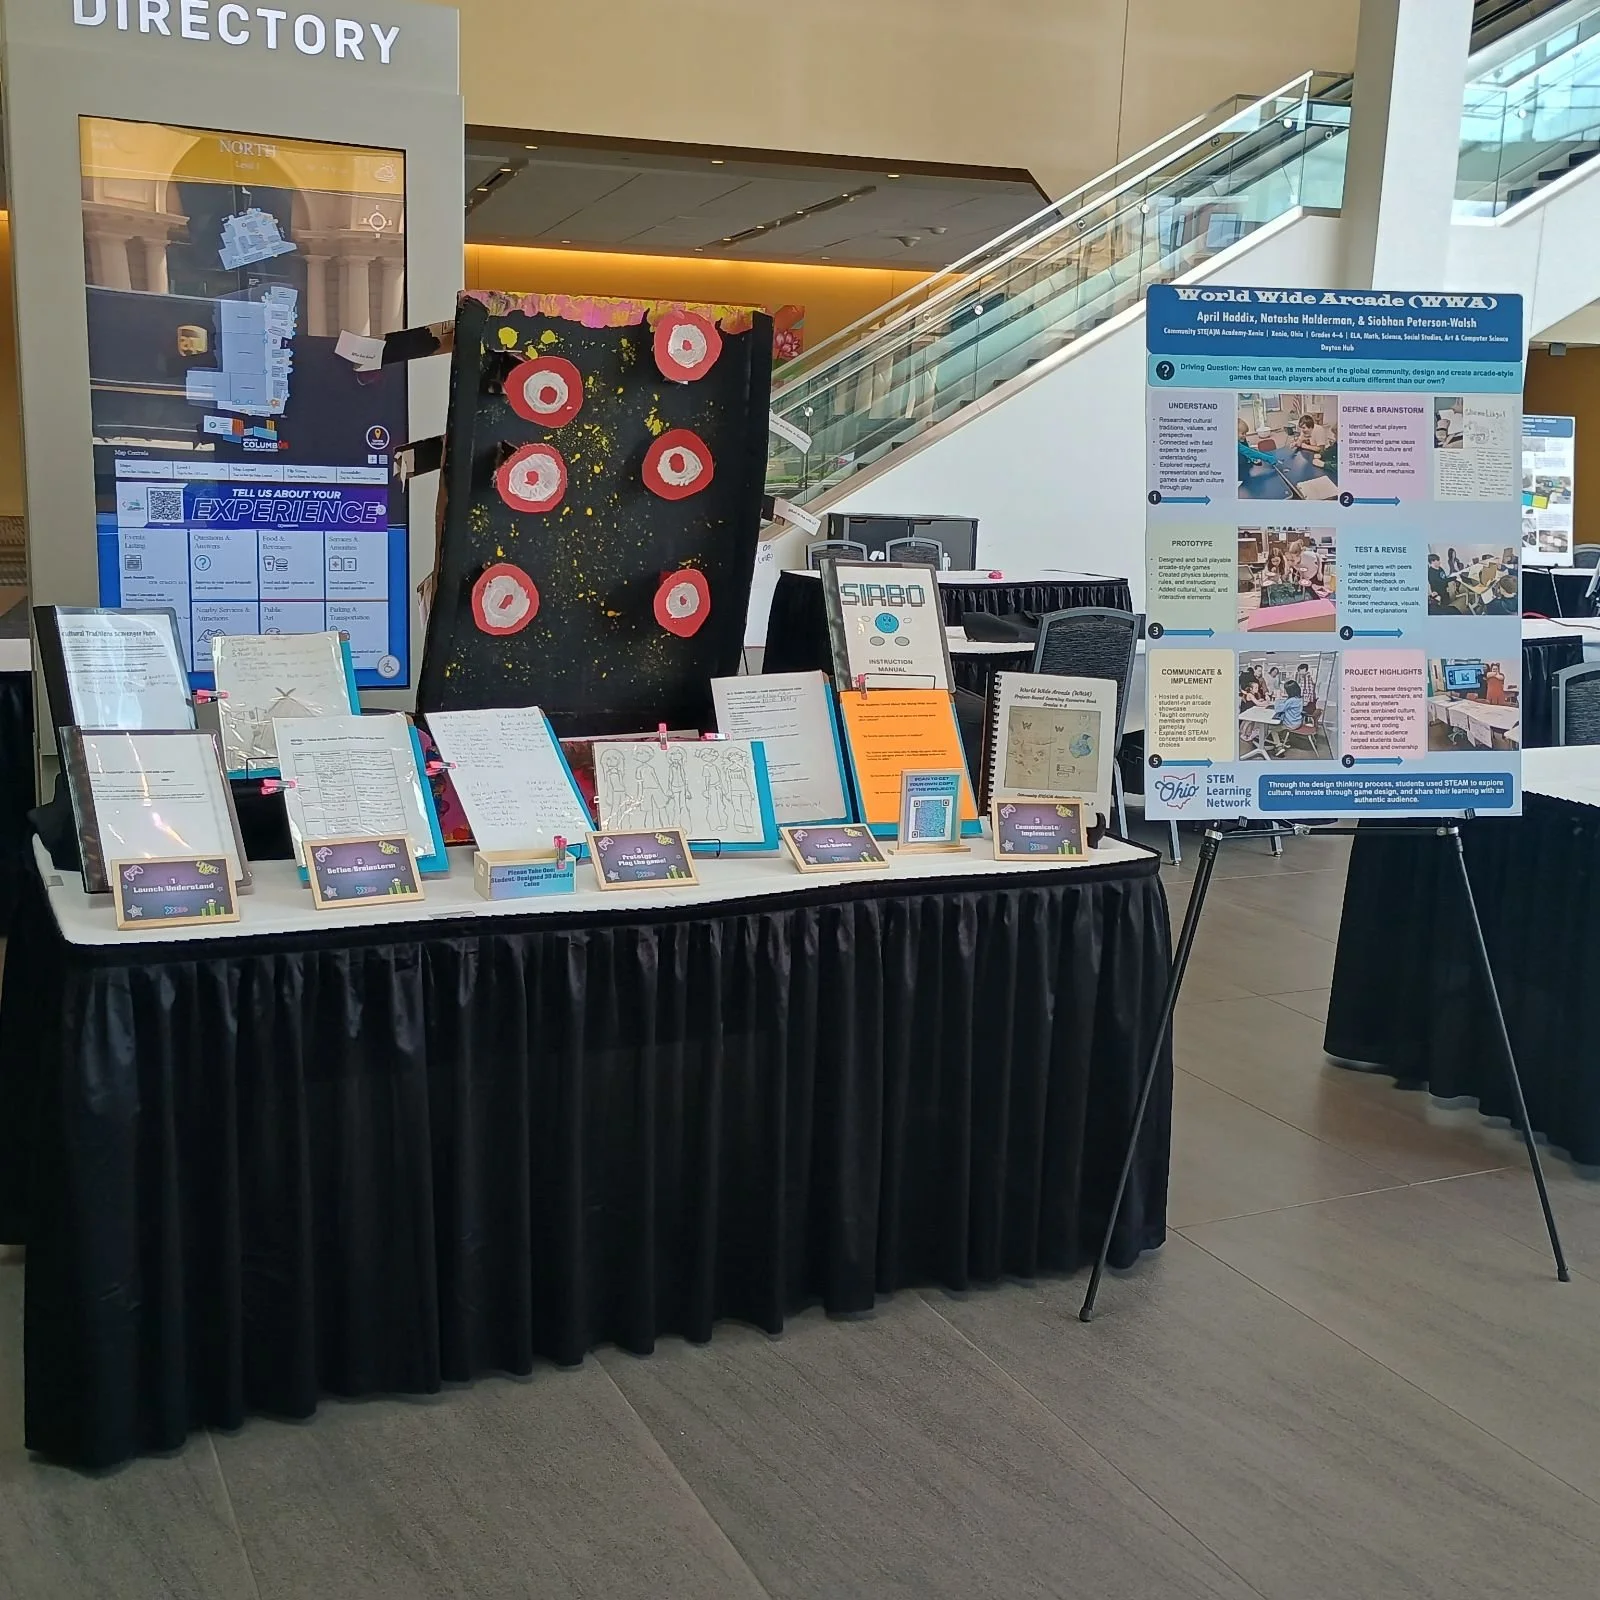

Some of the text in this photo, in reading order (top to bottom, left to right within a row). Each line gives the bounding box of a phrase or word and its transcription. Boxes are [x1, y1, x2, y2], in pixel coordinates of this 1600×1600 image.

[73, 0, 400, 64] DIRECTORY
[220, 139, 278, 158] NORTH
[1175, 288, 1498, 310] World Wide Arcade (WWA)
[1197, 312, 1477, 328] April Haddix, Natasha Halderman, & Siobhan Peterson-Walsh
[1164, 327, 1196, 336] Community
[1197, 328, 1221, 337] STE(A)M
[1271, 330, 1289, 338] Xenia,
[1350, 332, 1362, 340] ELA,
[1382, 333, 1402, 341] Science,
[1421, 334, 1443, 342] Studies,
[1461, 334, 1488, 342] Computer
[1321, 344, 1341, 352] Dayton
[1180, 363, 1204, 372] Driving
[1206, 364, 1239, 372] Question:
[1372, 368, 1410, 376] community,
[1412, 369, 1435, 377] design
[1473, 370, 1513, 378] arcade-style
[1288, 375, 1313, 383] players
[1168, 402, 1218, 410] UNDERSTAND
[232, 489, 341, 499] TELL US ABOUT YOUR
[192, 498, 381, 524] EXPERIENCE
[1152, 627, 1159, 635] 3
[1344, 629, 1349, 637] 4
[1345, 757, 1351, 765] 6
[1206, 775, 1234, 783] STEM
[1269, 781, 1298, 789] Through
[1311, 781, 1335, 789] design
[1336, 780, 1363, 788] thinking
[1155, 781, 1199, 802] Ohio
[1206, 786, 1252, 797] Learning
[1325, 788, 1352, 796] through
[1374, 788, 1399, 796] design,
[1451, 787, 1478, 795] learning
[1206, 799, 1251, 807] Network
[133, 882, 214, 893] Launch/Understand
